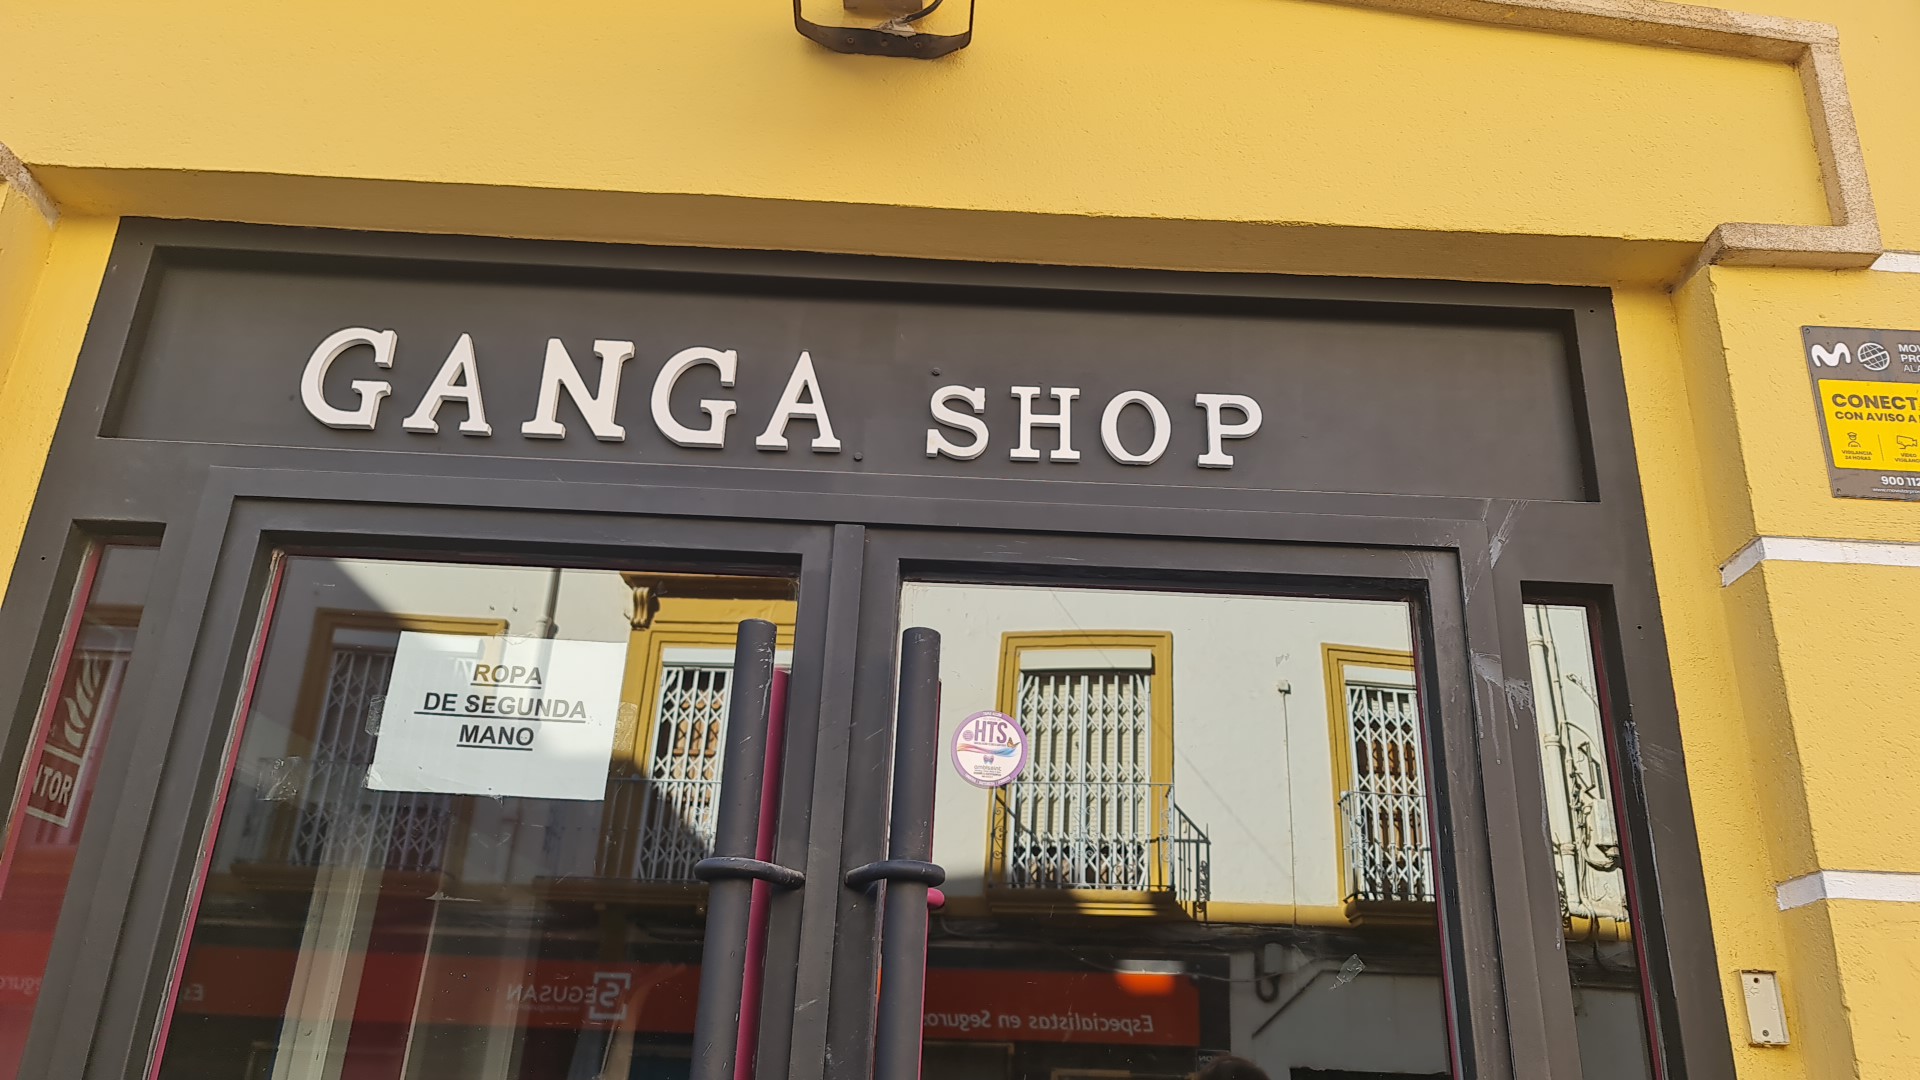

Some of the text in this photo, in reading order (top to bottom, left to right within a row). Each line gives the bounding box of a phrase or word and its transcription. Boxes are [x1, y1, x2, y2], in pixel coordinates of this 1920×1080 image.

[301, 327, 1263, 468] GANGA SHOP
[1832, 393, 1920, 411] CONECT
[1835, 411, 1864, 420] CON
[1866, 413, 1905, 422] AVISO
[1908, 415, 1917, 423] A
[1881, 476, 1905, 486] 900
[473, 664, 542, 685] ROPA
[423, 692, 587, 719] DE SEGUNDA
[459, 724, 535, 746] MANO
[974, 720, 1008, 744] HTS
